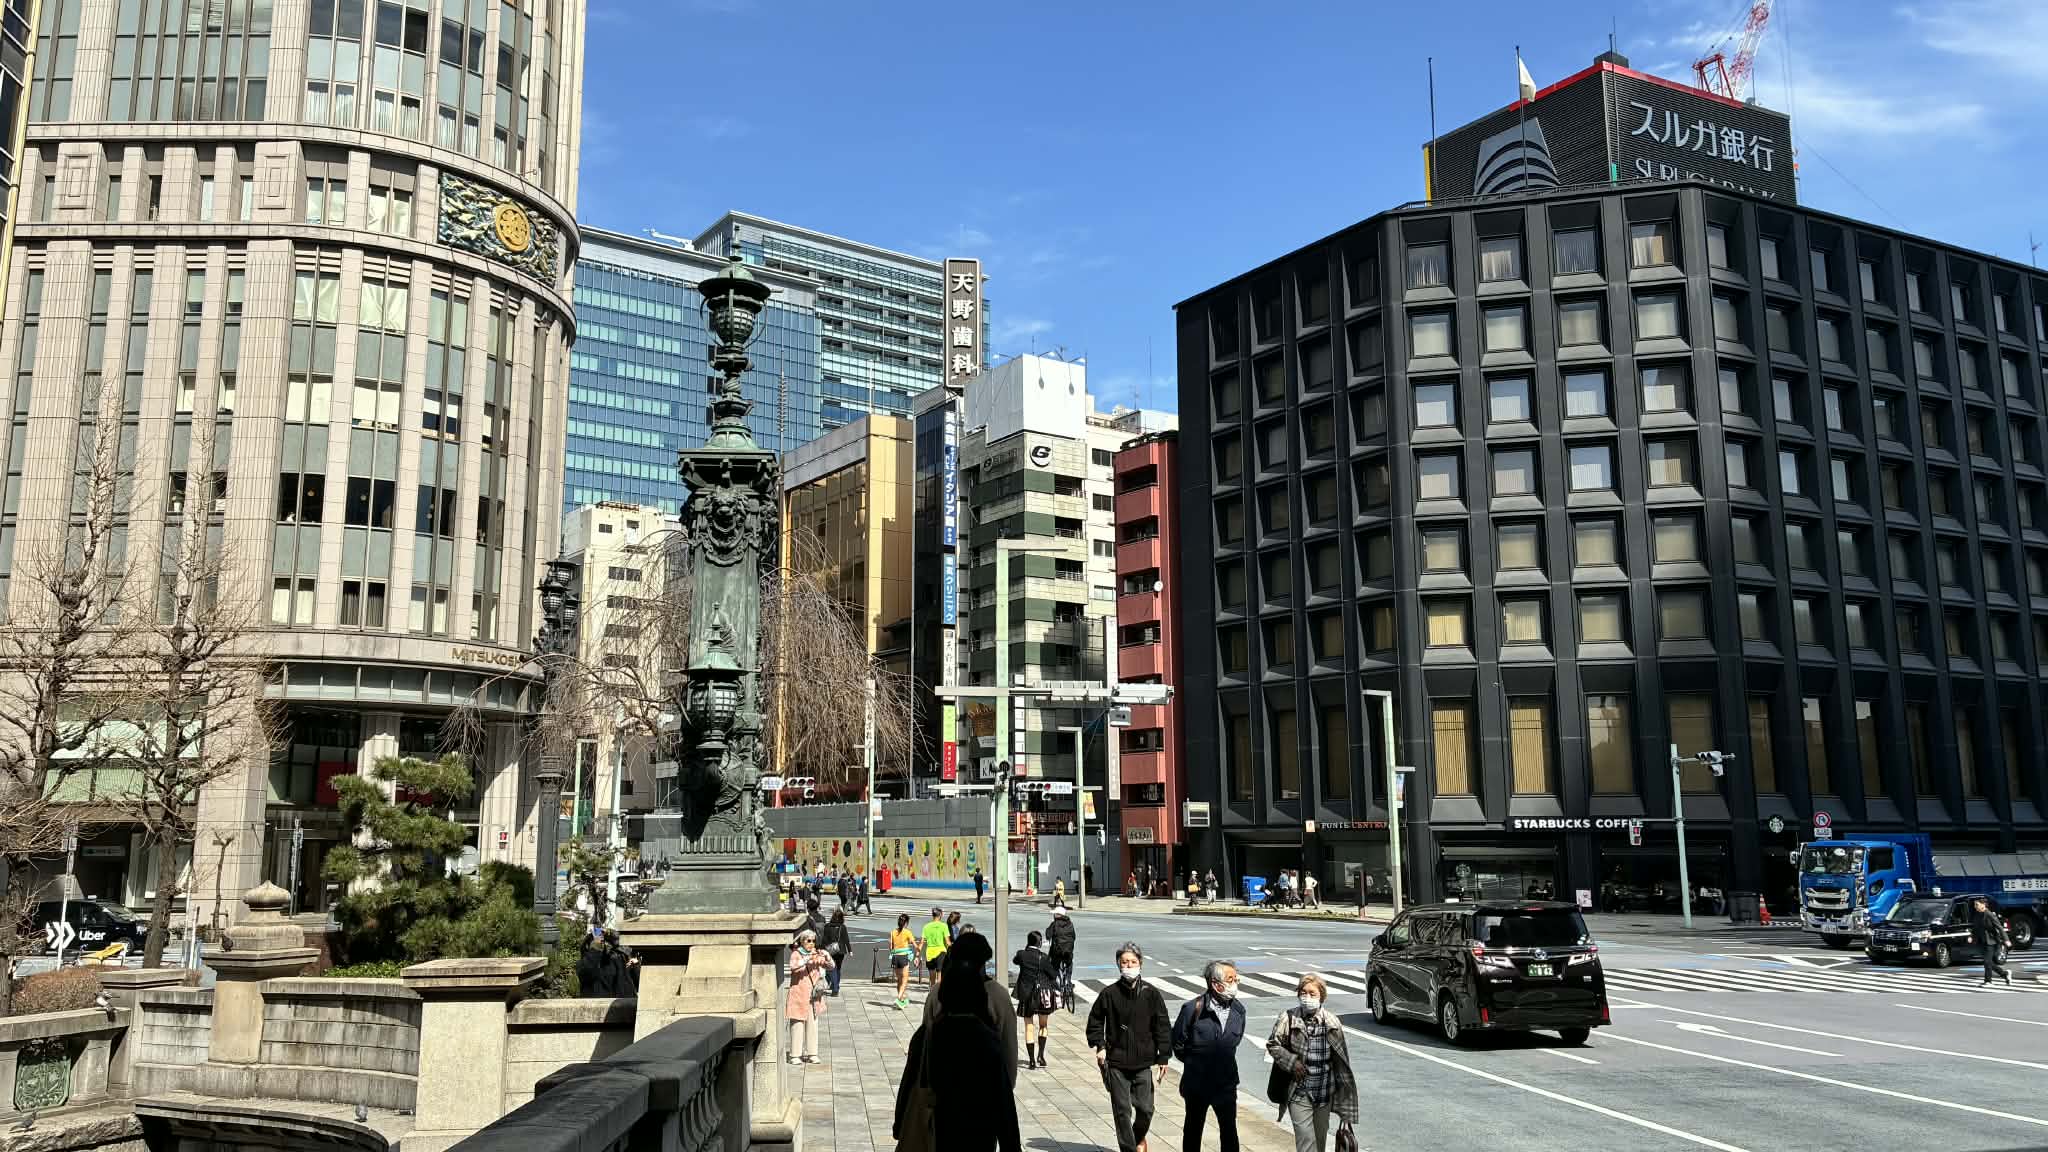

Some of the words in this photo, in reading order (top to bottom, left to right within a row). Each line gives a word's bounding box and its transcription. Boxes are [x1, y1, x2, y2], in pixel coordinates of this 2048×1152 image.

[1631, 101, 1774, 172] スルガ銀行
[951, 272, 975, 376] 天野歯科
[452, 647, 523, 667] MITSUKOSH
[1514, 818, 1591, 829] STARBUCKS
[1595, 818, 1644, 829] COFFE
[79, 930, 106, 941] Uber
